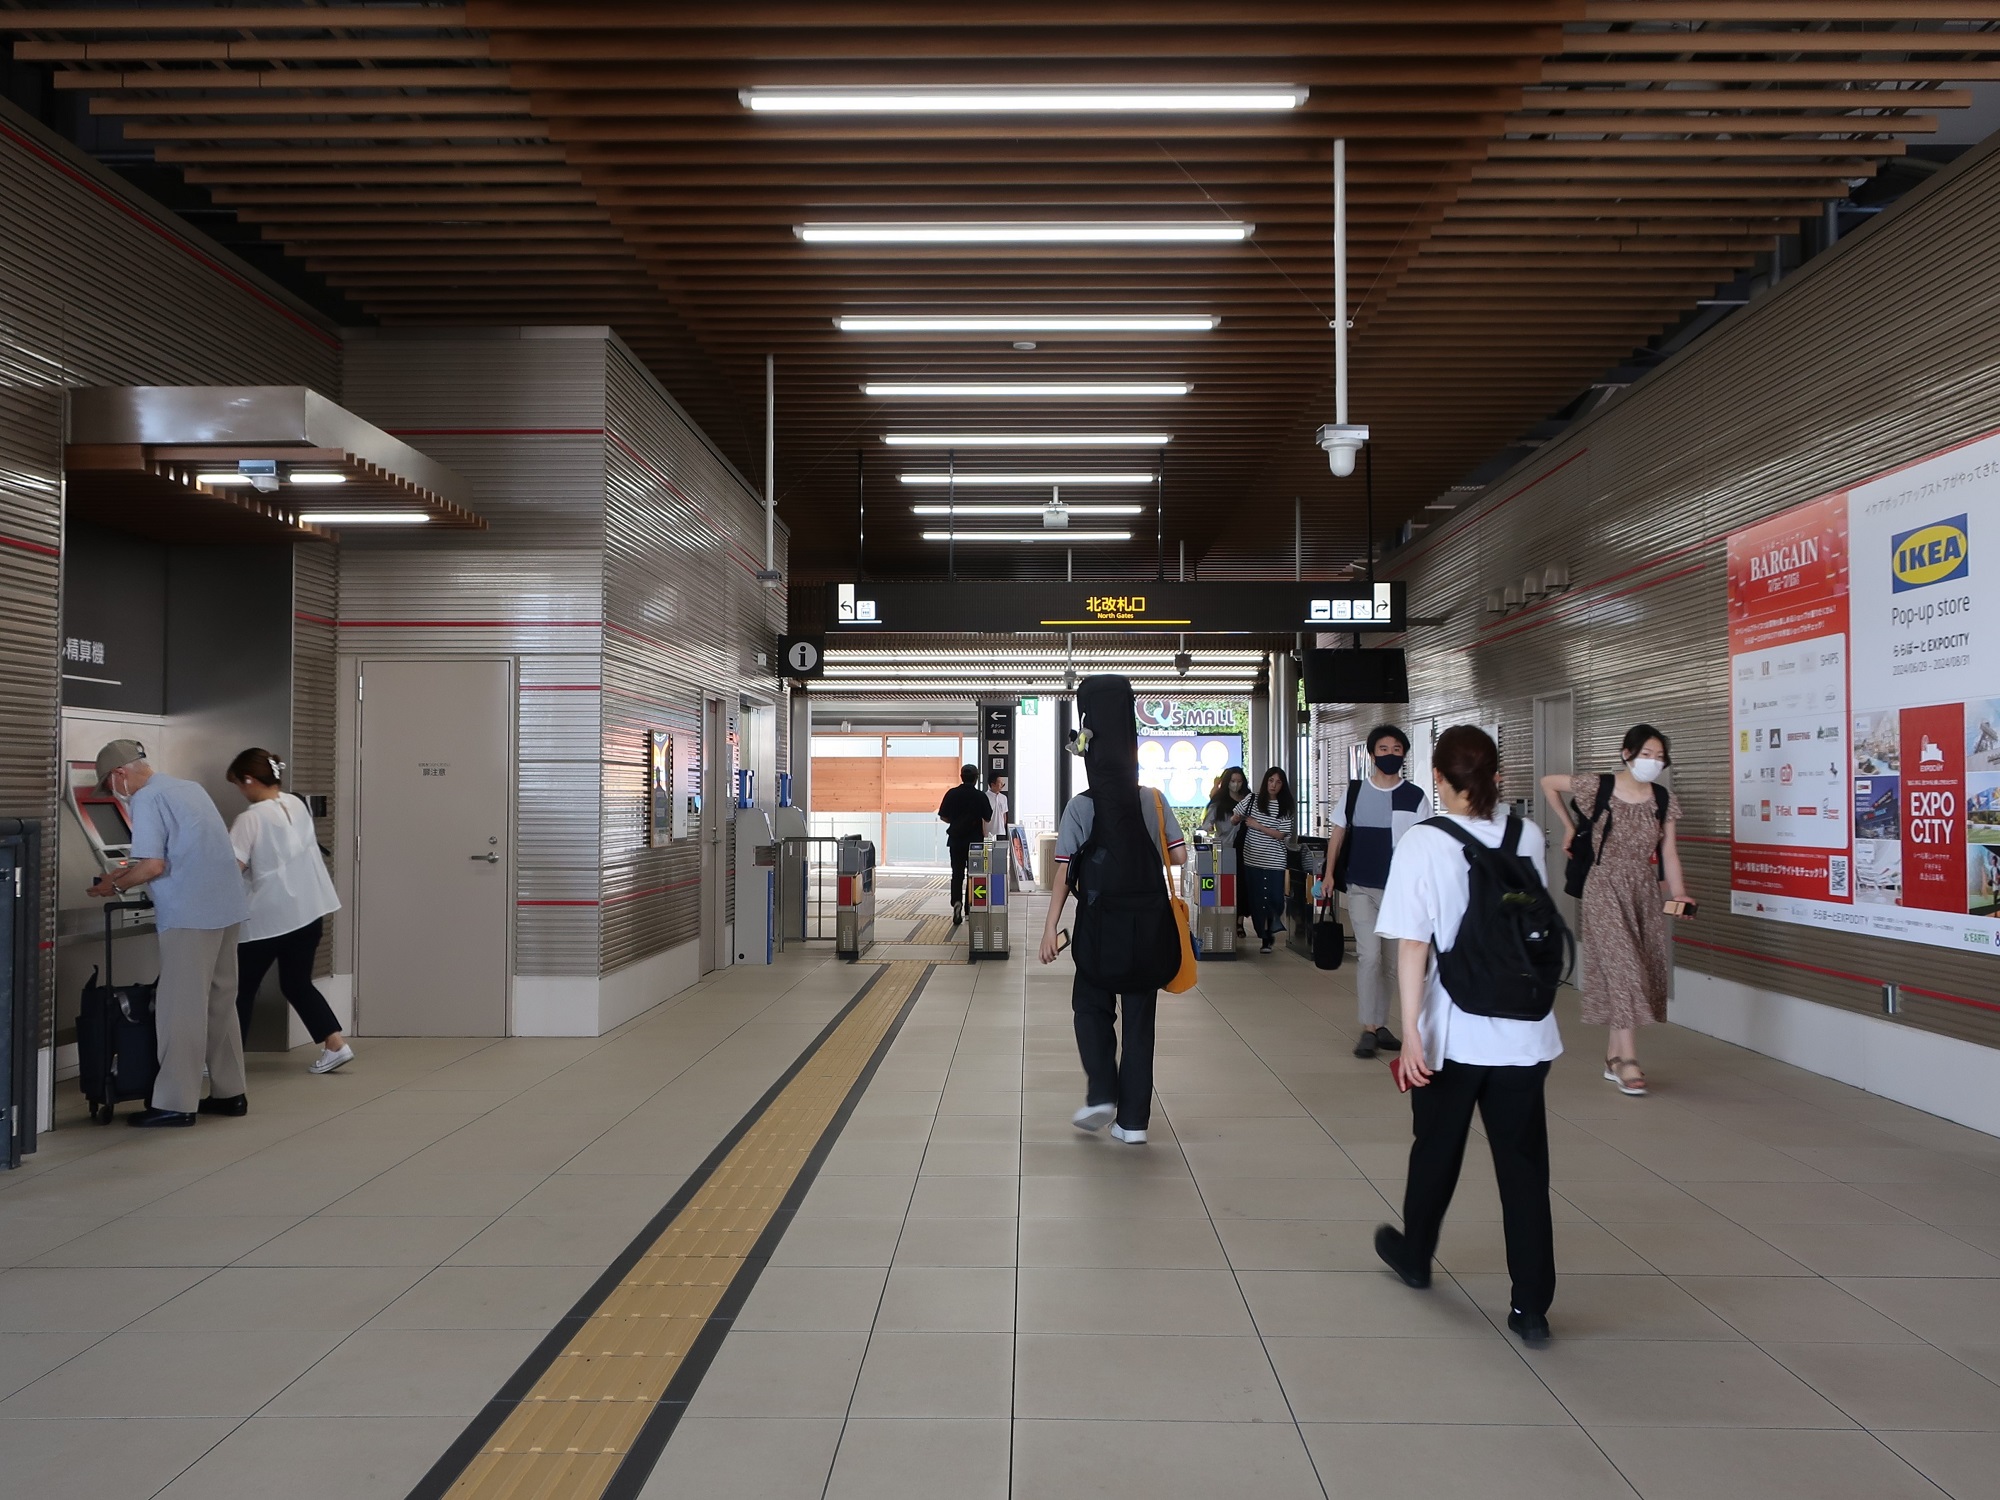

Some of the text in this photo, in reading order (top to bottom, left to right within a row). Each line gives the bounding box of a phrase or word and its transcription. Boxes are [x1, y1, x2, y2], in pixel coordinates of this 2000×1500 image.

[1750, 536, 1819, 581] BARGAIN
[1899, 535, 1961, 573] IKEA
[1086, 597, 1145, 612] 北改札口
[1892, 596, 1970, 629] Pop-up store
[62, 637, 105, 664] 精算機
[1187, 711, 1234, 725] MALL
[1910, 791, 1955, 817] EXPO
[1910, 819, 1954, 844] CITY
[1202, 878, 1214, 889] IC
